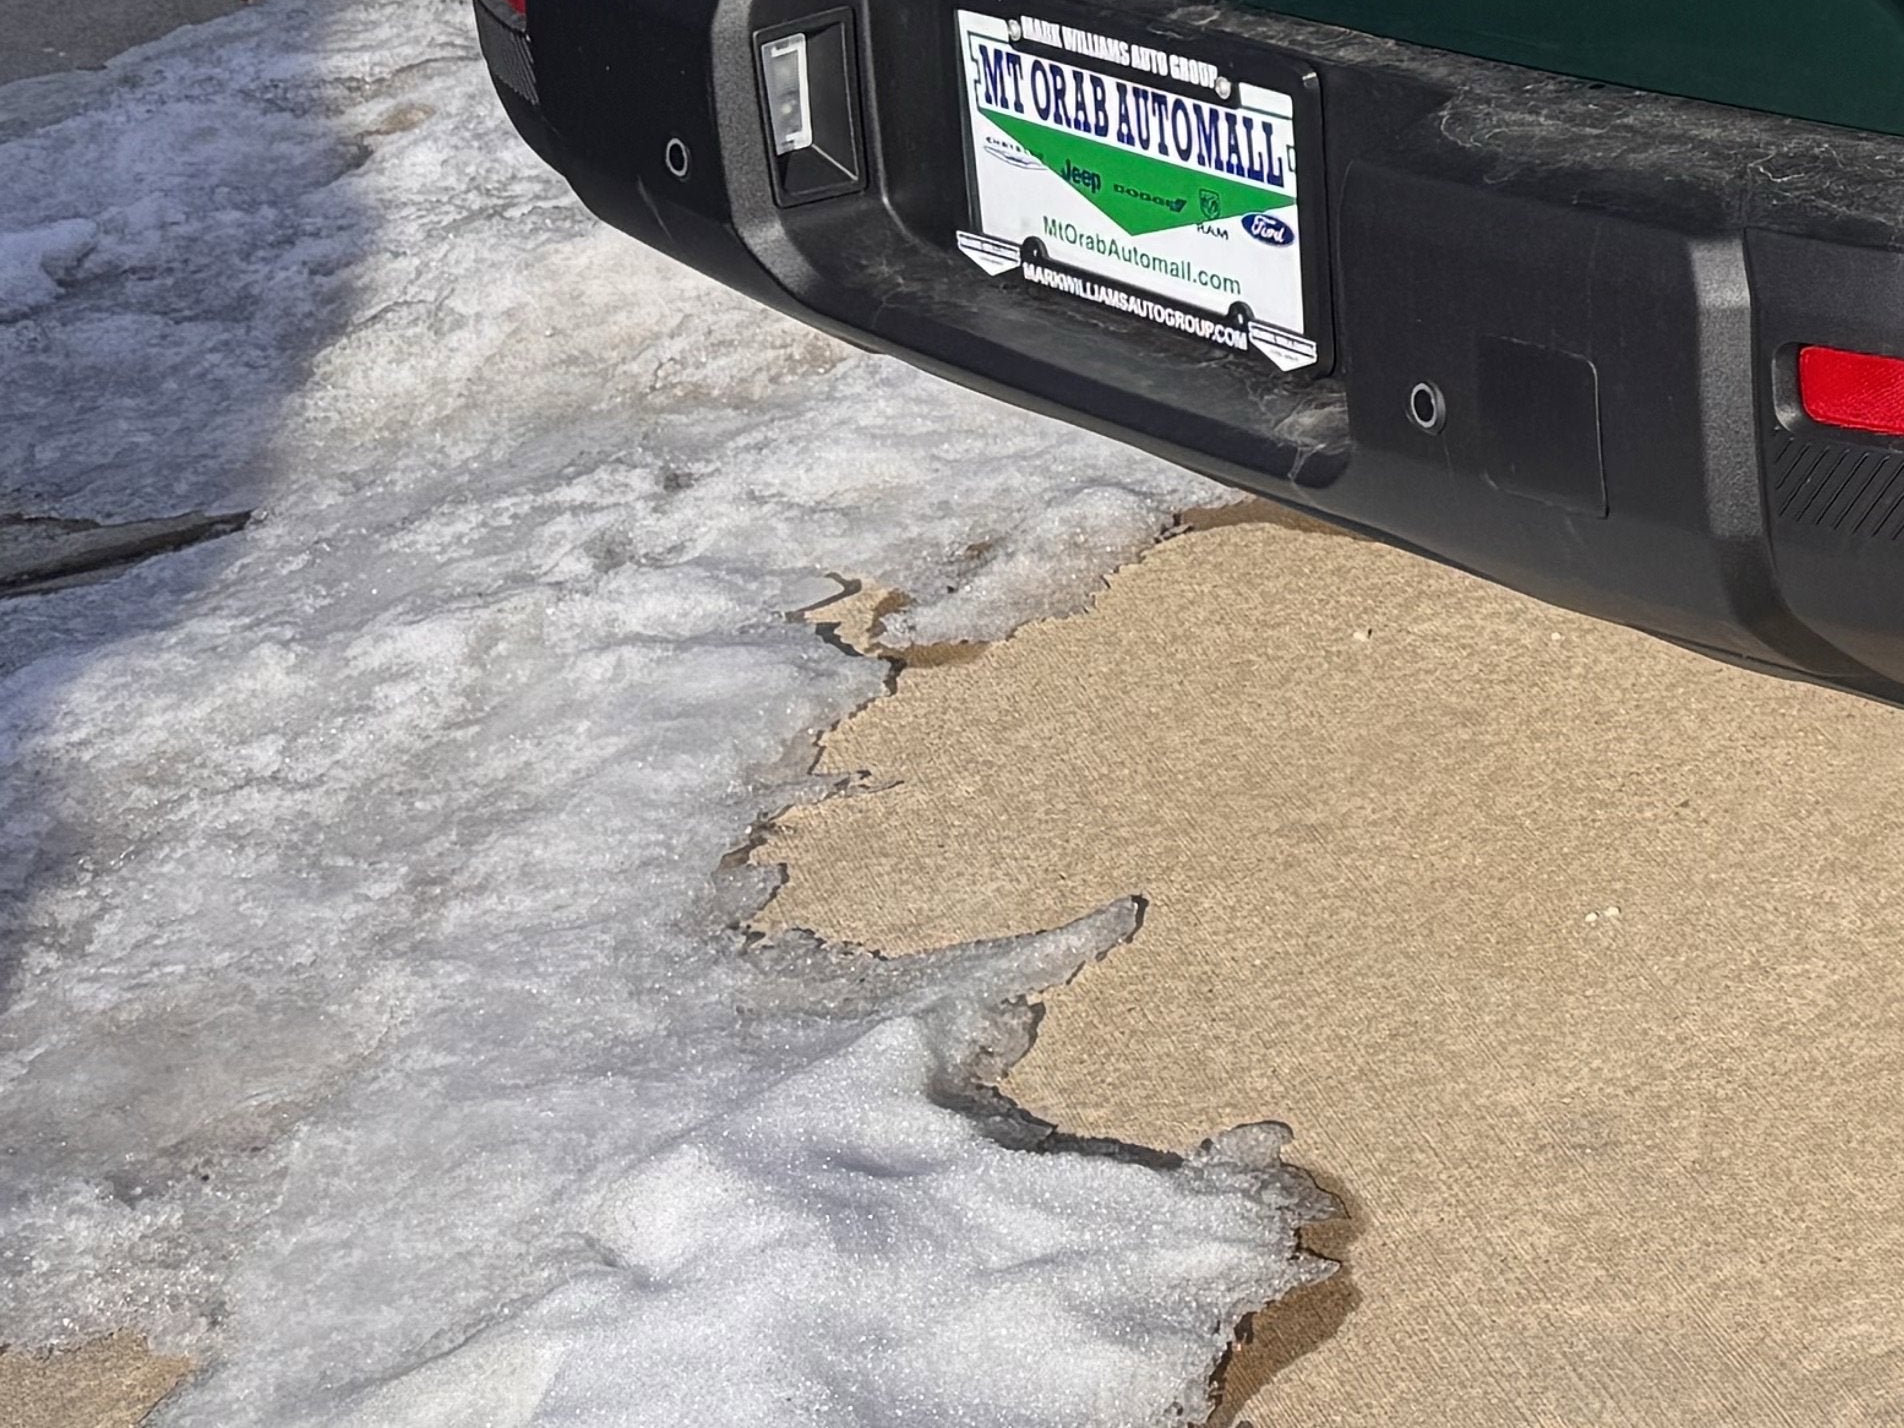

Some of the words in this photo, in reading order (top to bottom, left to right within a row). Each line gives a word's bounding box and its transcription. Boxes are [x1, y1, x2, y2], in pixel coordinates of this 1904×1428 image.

[1021, 15, 1063, 49] MARK
[1061, 26, 1130, 66] WILLIAMS
[1130, 44, 1168, 76] AUTO
[1169, 54, 1218, 89] GROUP
[979, 45, 1025, 114] MT
[1030, 59, 1109, 137] ORAB
[1116, 81, 1284, 188] AUTOMALL
[1061, 158, 1102, 194] Jeep
[1043, 215, 1242, 296] MtOrabAutomall.com
[1197, 222, 1229, 241] RAM
[1252, 215, 1285, 243] Ford
[1022, 262, 1249, 351] MARKWILLIAMSAUTOGROUP.COM
